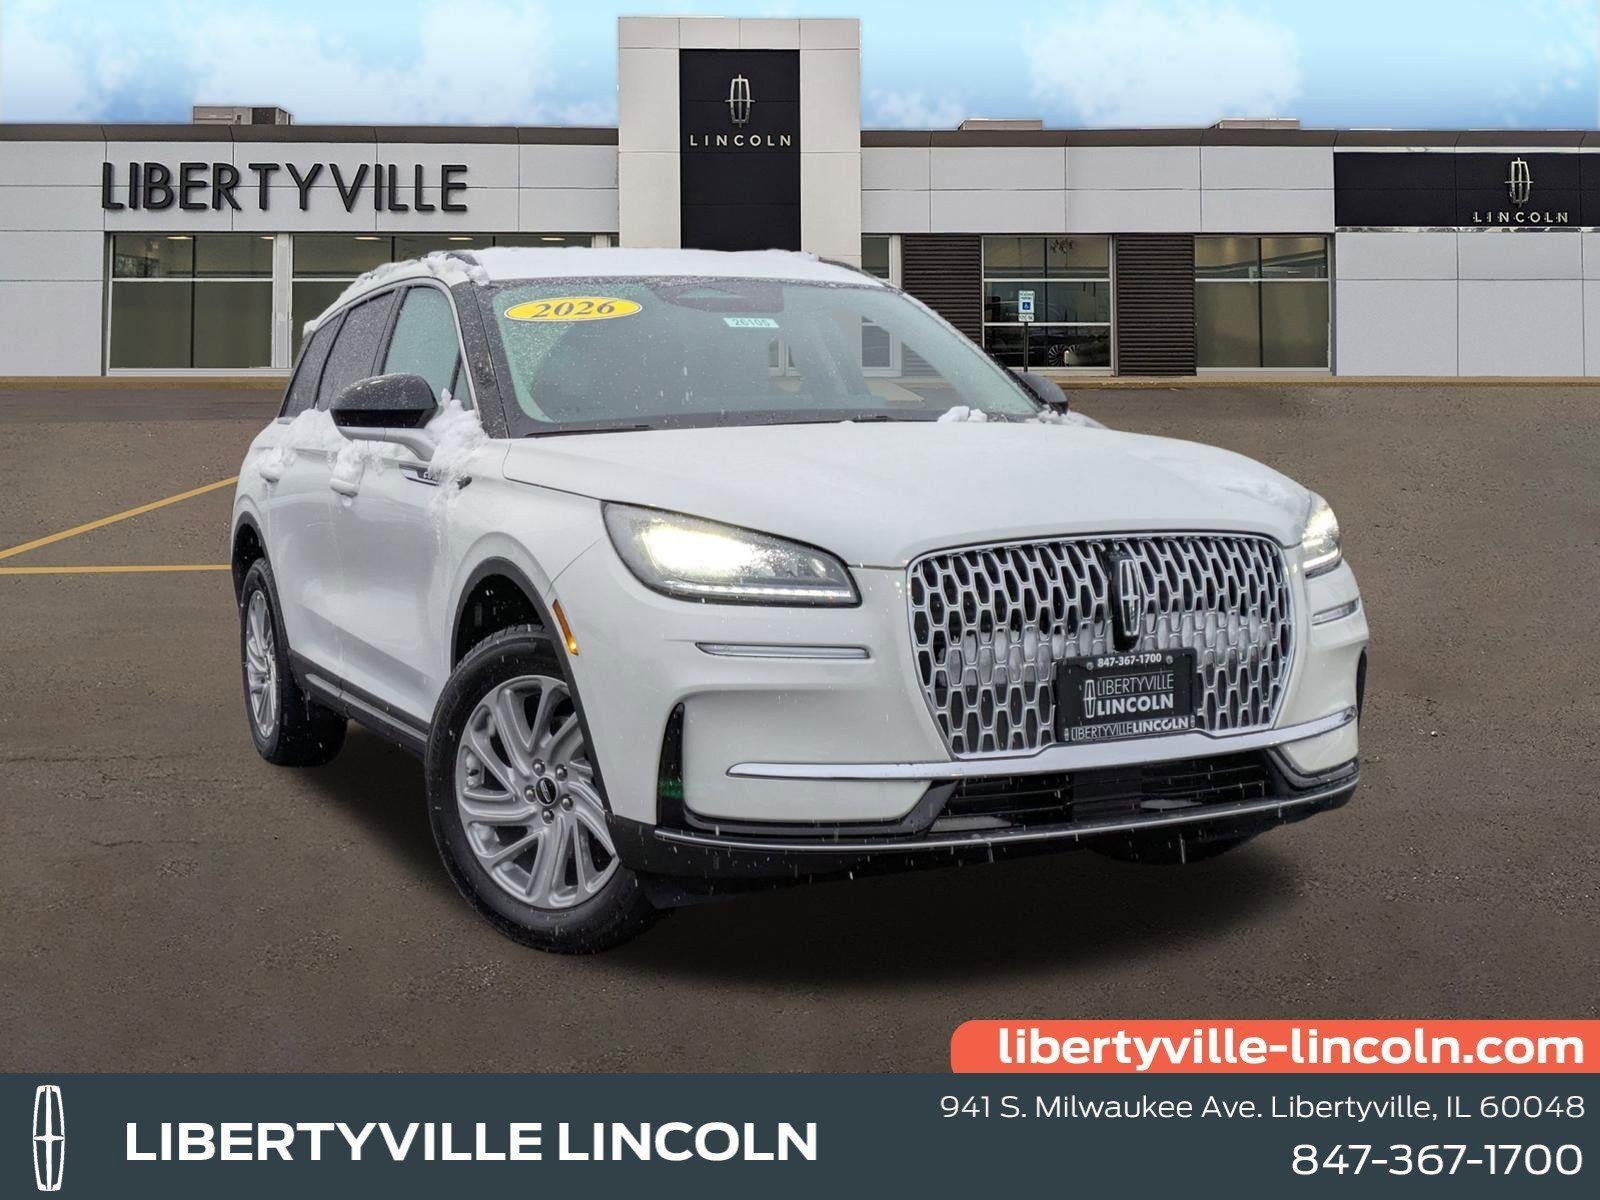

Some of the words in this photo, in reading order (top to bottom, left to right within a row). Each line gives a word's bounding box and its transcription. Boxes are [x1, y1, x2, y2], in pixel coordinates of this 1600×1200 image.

[690, 135, 791, 146] LINCOLN
[102, 162, 468, 212] LIBERTYVILLE
[1473, 212, 1568, 223] LINCOLN
[532, 301, 617, 318] 2026
[1098, 653, 1162, 667] 847-367-1700
[1098, 673, 1174, 696] LIBERTYVILLE
[1097, 693, 1174, 716] LINCOLN
